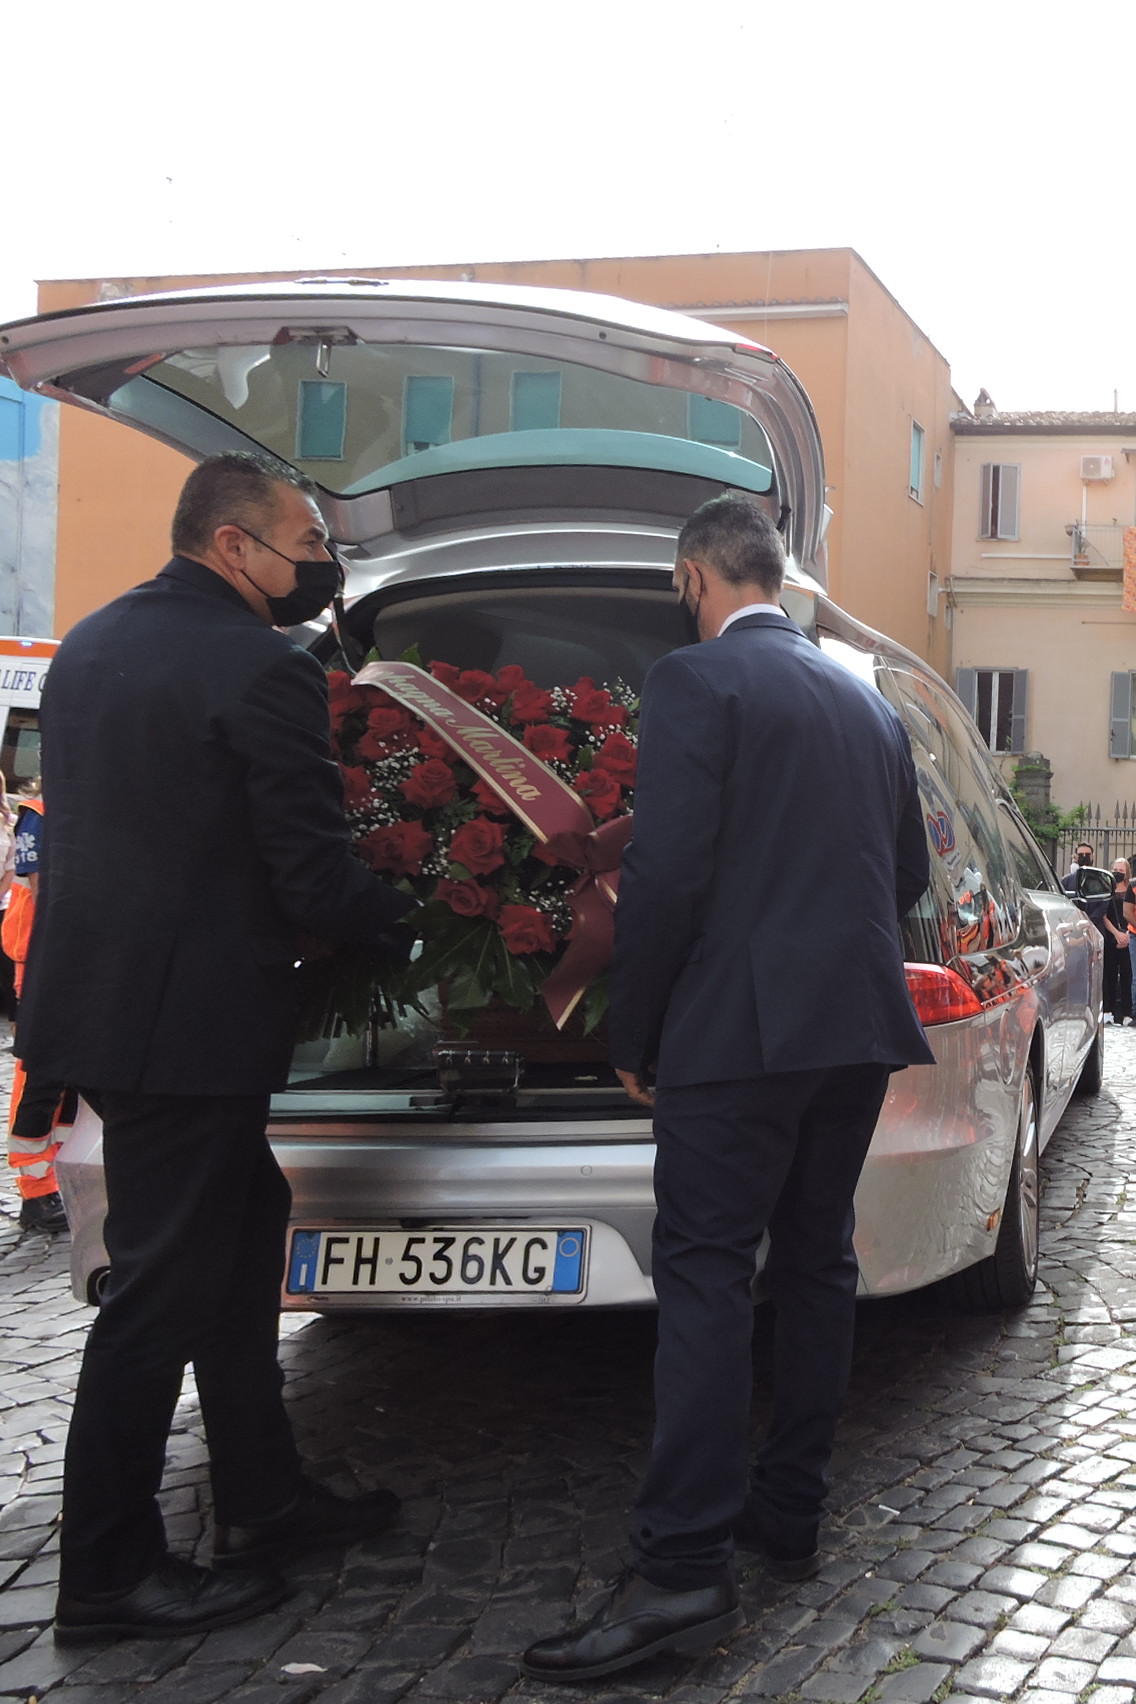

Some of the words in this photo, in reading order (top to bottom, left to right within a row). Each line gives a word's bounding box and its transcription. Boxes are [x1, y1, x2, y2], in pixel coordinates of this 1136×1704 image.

[1, 670, 36, 691] LIFE
[445, 718, 542, 801] Martina
[321, 1237, 379, 1285] FH
[399, 1236, 549, 1285] 536KG
